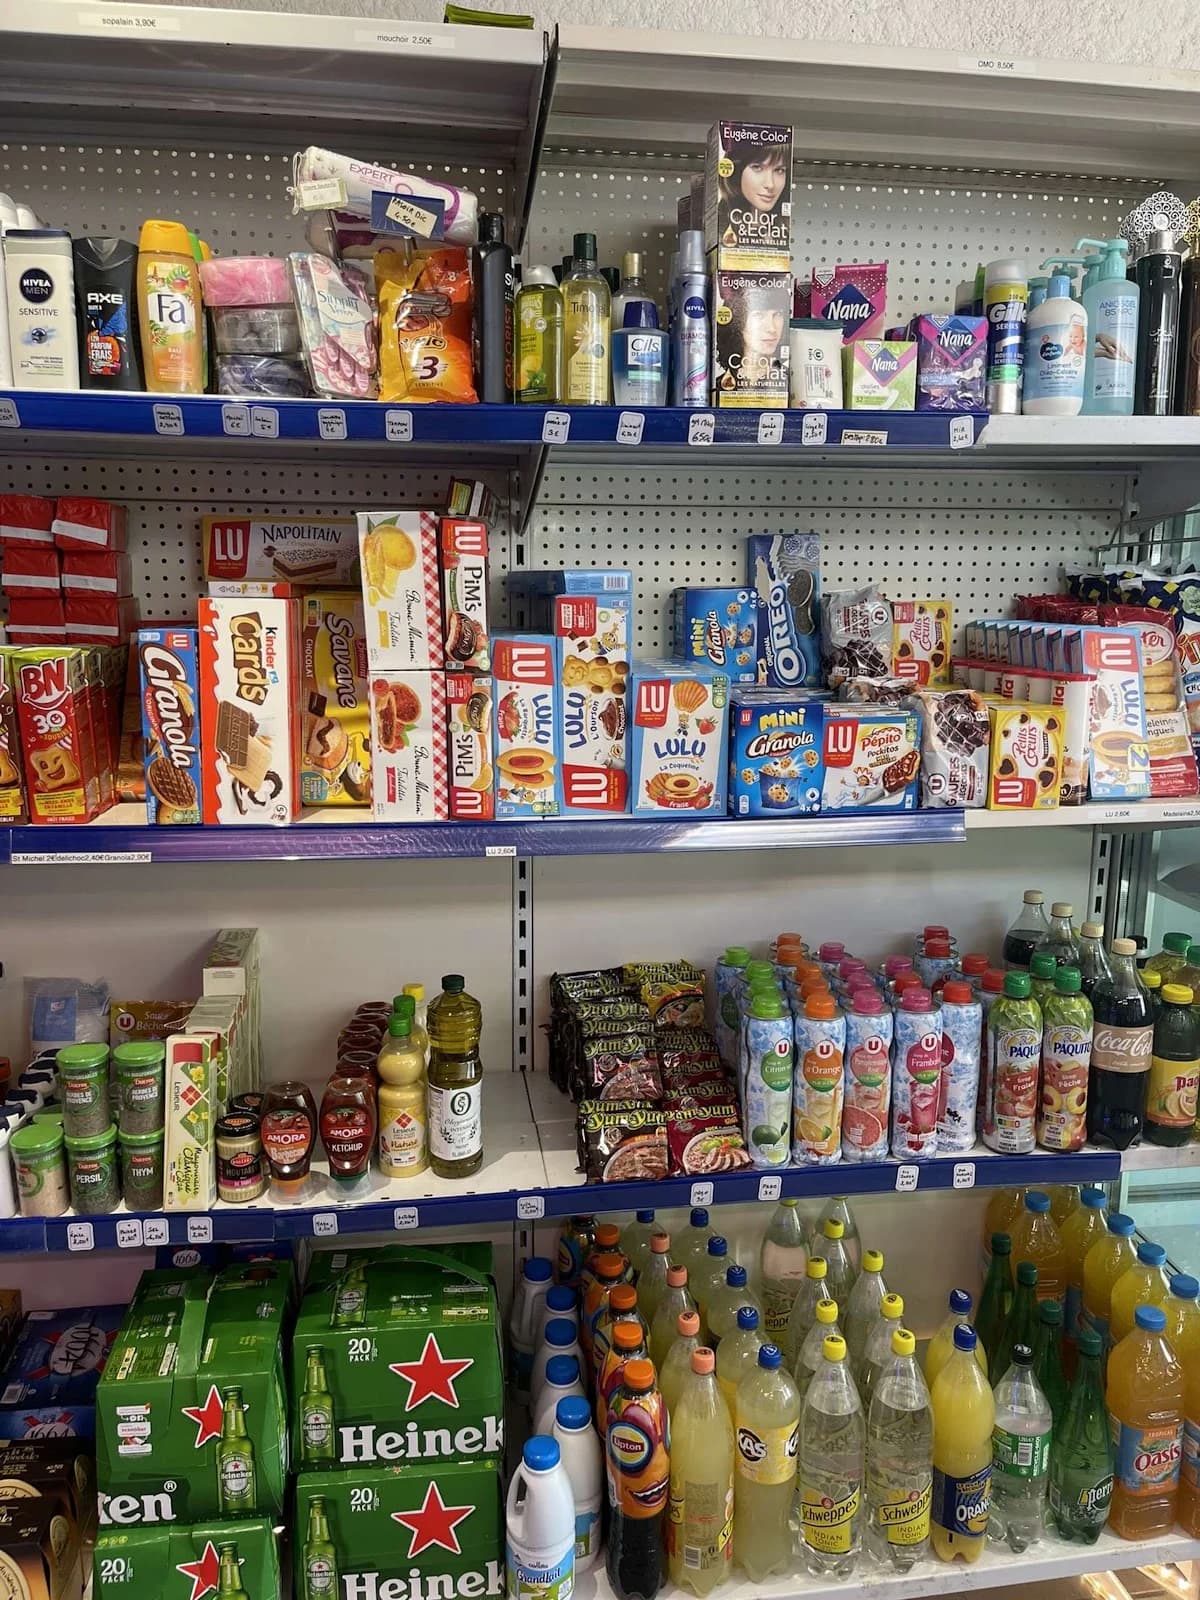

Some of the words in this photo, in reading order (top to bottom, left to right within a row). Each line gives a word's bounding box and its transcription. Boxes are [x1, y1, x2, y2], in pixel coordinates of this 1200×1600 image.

[102, 17, 133, 26] sopalain
[377, 34, 409, 43] mouchoir
[412, 36, 432, 45] 2,50€
[723, 127, 758, 141] Eugène
[760, 130, 788, 143] Color
[350, 163, 395, 183] EXPERT
[730, 208, 777, 225] Color
[750, 239, 787, 247] NATURELLES
[23, 279, 52, 287] NIVEA
[25, 287, 49, 295] MEN
[721, 276, 757, 290] Eugène
[758, 278, 787, 288] Color
[87, 292, 124, 305] AXE
[19, 308, 60, 317] SENSITIVE
[157, 293, 187, 325] Fa
[827, 300, 871, 320] Nana
[1104, 308, 1113, 317] 85
[995, 323, 1019, 331] SERIES
[631, 338, 660, 353] Cils
[938, 330, 974, 347] Nana
[91, 349, 113, 361] FRAIS
[504, 306, 513, 390] COLORIST
[419, 355, 440, 381] 3
[728, 353, 776, 369] Color
[871, 357, 898, 372] Nana
[213, 527, 243, 561] LU
[260, 524, 342, 544] NAPOLITAIN
[455, 526, 482, 551] LU
[464, 566, 483, 612] PiM's
[172, 633, 188, 648] LU
[707, 609, 727, 666] Granola
[770, 586, 801, 681] OREO
[265, 626, 278, 669] Kinder
[1100, 637, 1132, 665] LU
[230, 614, 270, 705] cards
[305, 638, 314, 678] CHOCOLAT
[324, 611, 358, 709] Savane
[511, 647, 546, 678] LU
[22, 659, 67, 698] BN
[898, 662, 919, 681] LU
[143, 644, 197, 769] Granola
[642, 685, 665, 713] LU
[1120, 679, 1140, 727] LULU
[532, 693, 552, 745] LULU
[565, 692, 588, 749] LULU
[741, 712, 751, 722] LU
[828, 726, 853, 753] LU
[1147, 728, 1175, 737] ngues
[653, 738, 706, 759] LULU
[748, 730, 815, 758] Granola
[861, 732, 901, 751] Pépito
[455, 733, 474, 778] PiM's
[867, 744, 899, 758] Pockitos
[571, 772, 608, 804] LU
[932, 778, 942, 790] U
[945, 755, 960, 807] GAUFRES
[997, 780, 1024, 803] LU
[456, 791, 482, 814] LU
[118, 1016, 131, 1028] U
[778, 1043, 788, 1054] U
[819, 1045, 829, 1054] U
[868, 1040, 879, 1050] U
[925, 1037, 934, 1047] U
[765, 1064, 786, 1073] Citron
[1012, 1080, 1035, 1092] Fraise
[1058, 1079, 1081, 1088] Pêche
[266, 1133, 306, 1145] AMORA
[329, 1127, 364, 1138] AMORA
[332, 1142, 364, 1153] KETCHUP
[76, 1174, 103, 1184] PERSIL
[132, 1167, 154, 1177] THYM
[348, 1337, 371, 1355] 20
[349, 1355, 370, 1363] PACK
[613, 1434, 643, 1453] Lipton
[1135, 1443, 1182, 1473] Oasis
[350, 1487, 373, 1505] 20
[351, 1503, 372, 1511] PACK
[801, 1497, 858, 1523] Schweppes
[810, 1527, 843, 1540] INDIAN
[896, 1522, 926, 1533] INDIAN
[900, 1531, 922, 1539] TONIC
[814, 1535, 839, 1546] TONIC
[101, 1557, 126, 1578] 20
[102, 1574, 125, 1584] PACK
